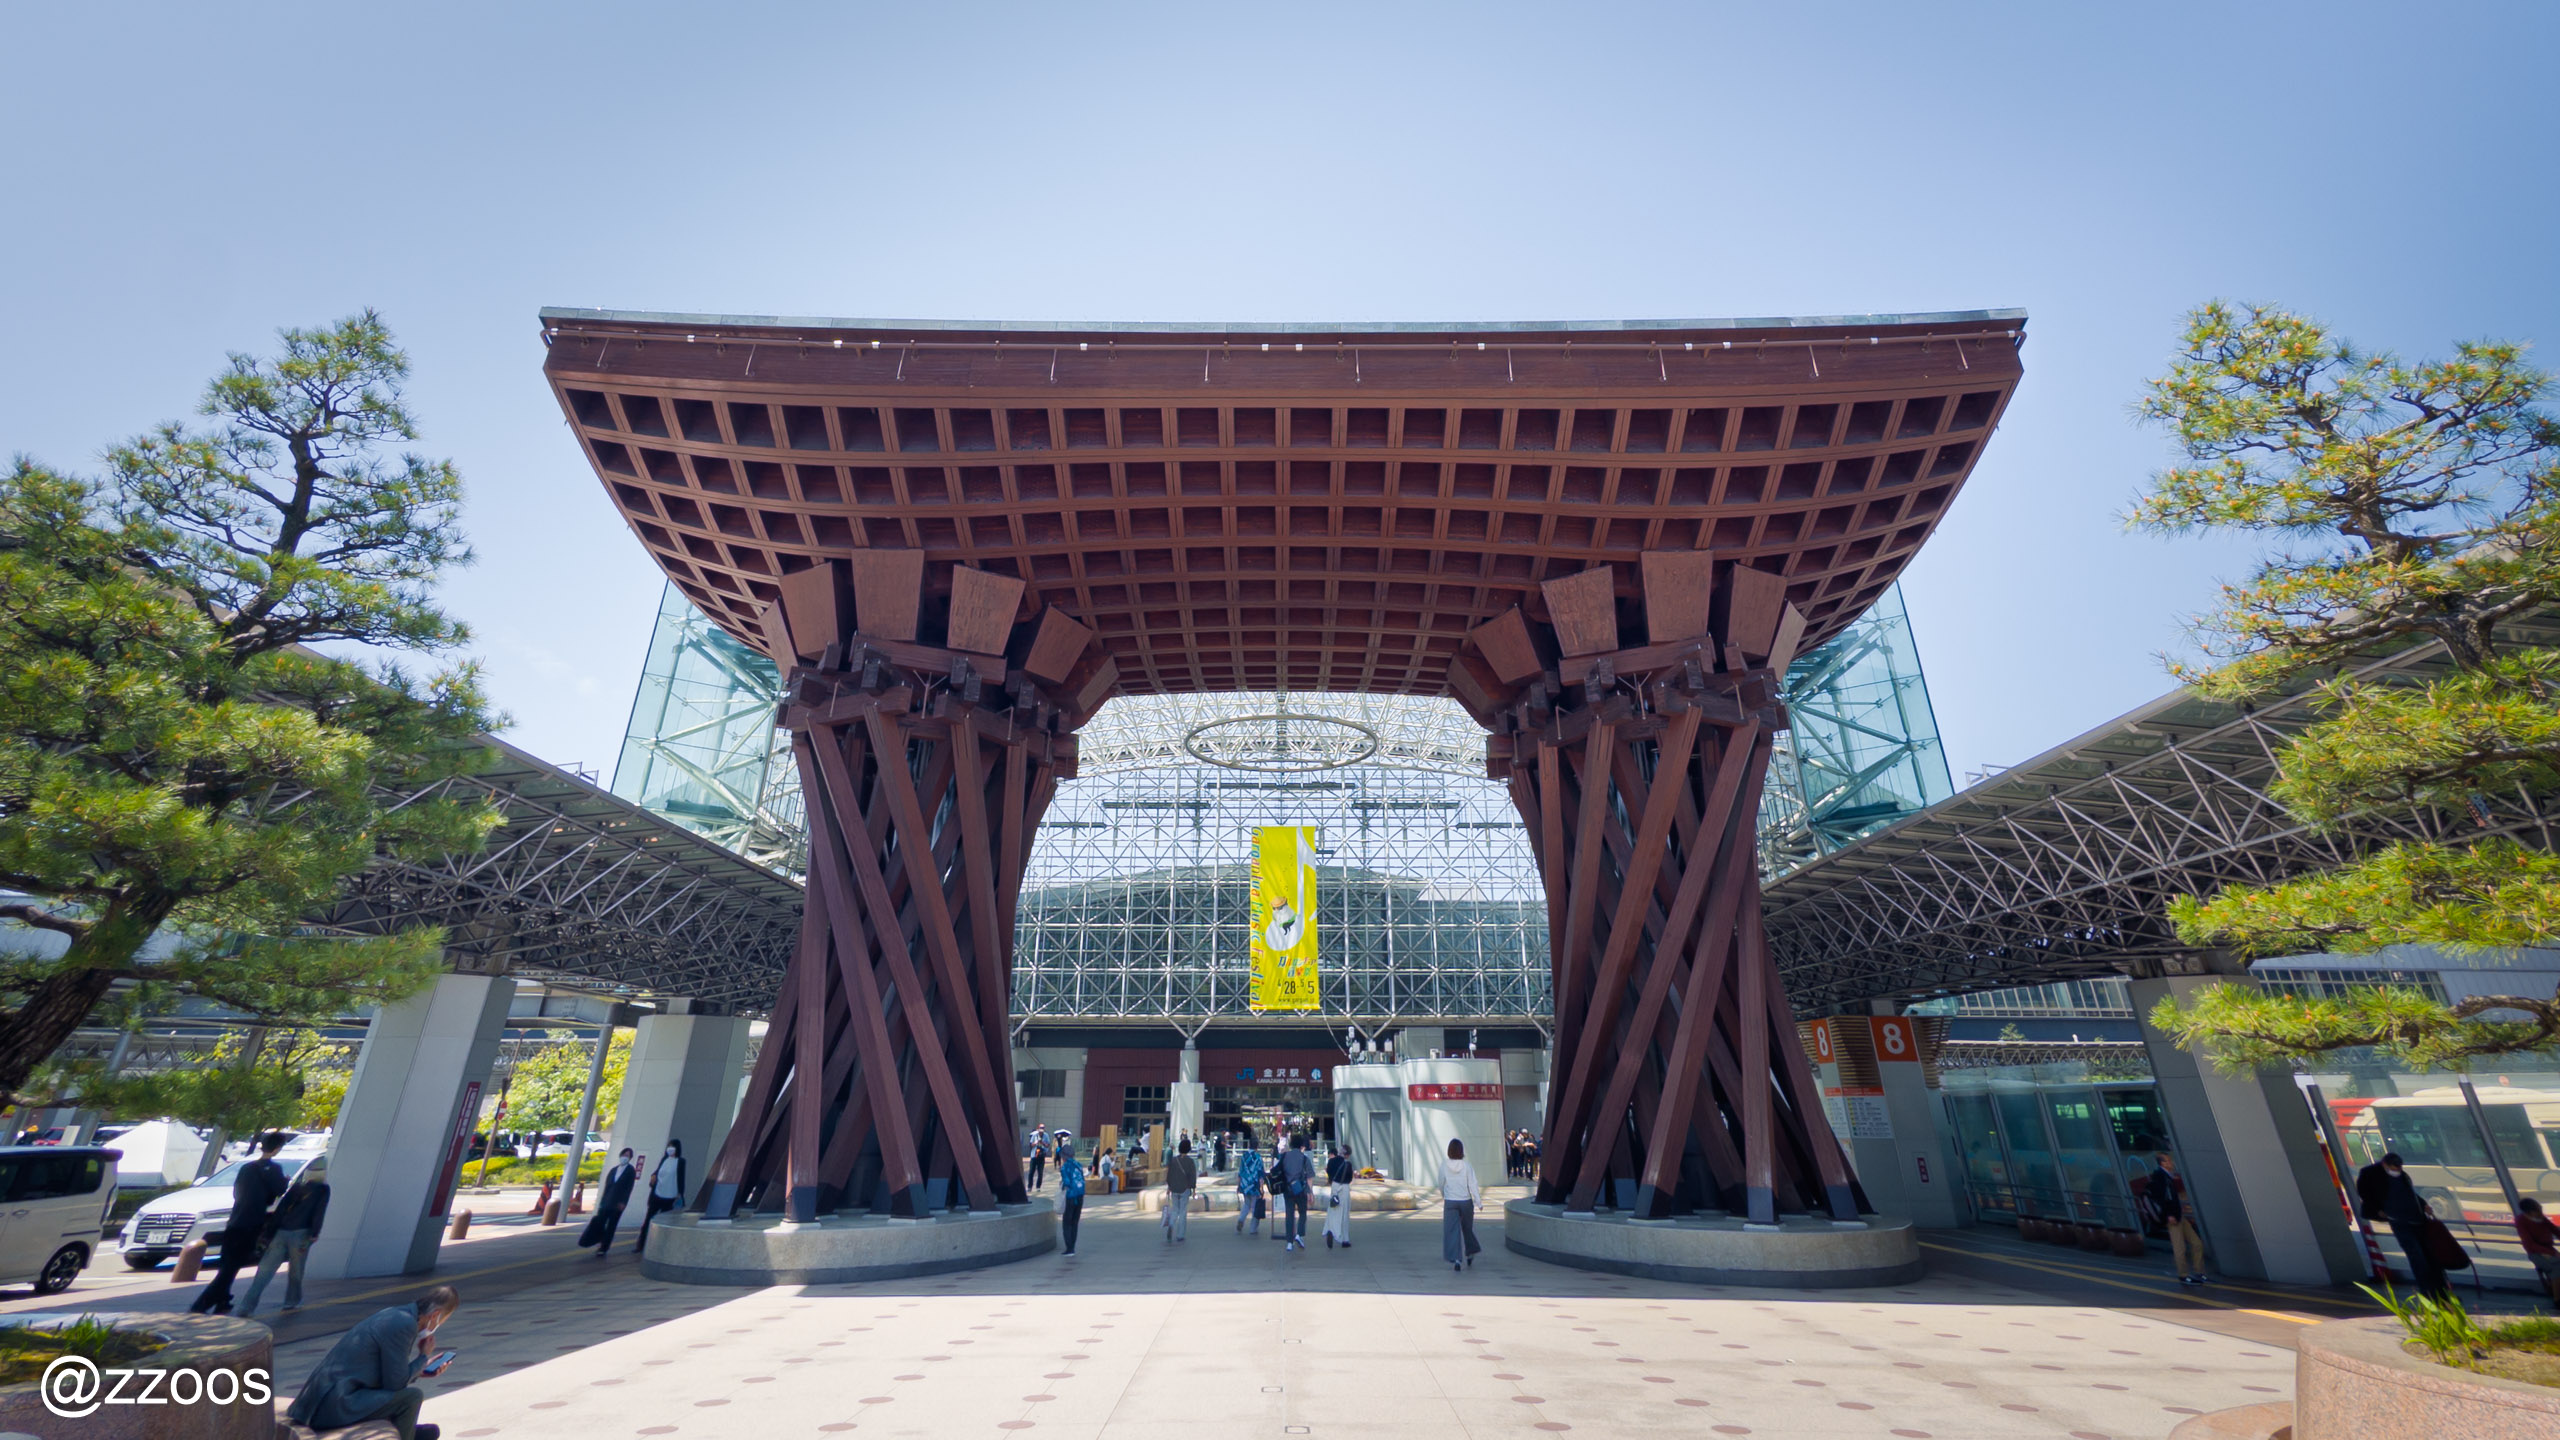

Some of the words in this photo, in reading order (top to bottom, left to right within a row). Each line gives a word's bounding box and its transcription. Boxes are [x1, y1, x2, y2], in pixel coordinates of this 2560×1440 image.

[1251, 826, 1263, 897] Gargantua
[1251, 901, 1264, 943] Music
[1251, 948, 1264, 1007] Festival
[1816, 1026, 1829, 1057] 8
[1882, 1023, 1905, 1055] 8
[1236, 1067, 1255, 1080] JR
[1263, 1068, 1299, 1078] 金沢駅
